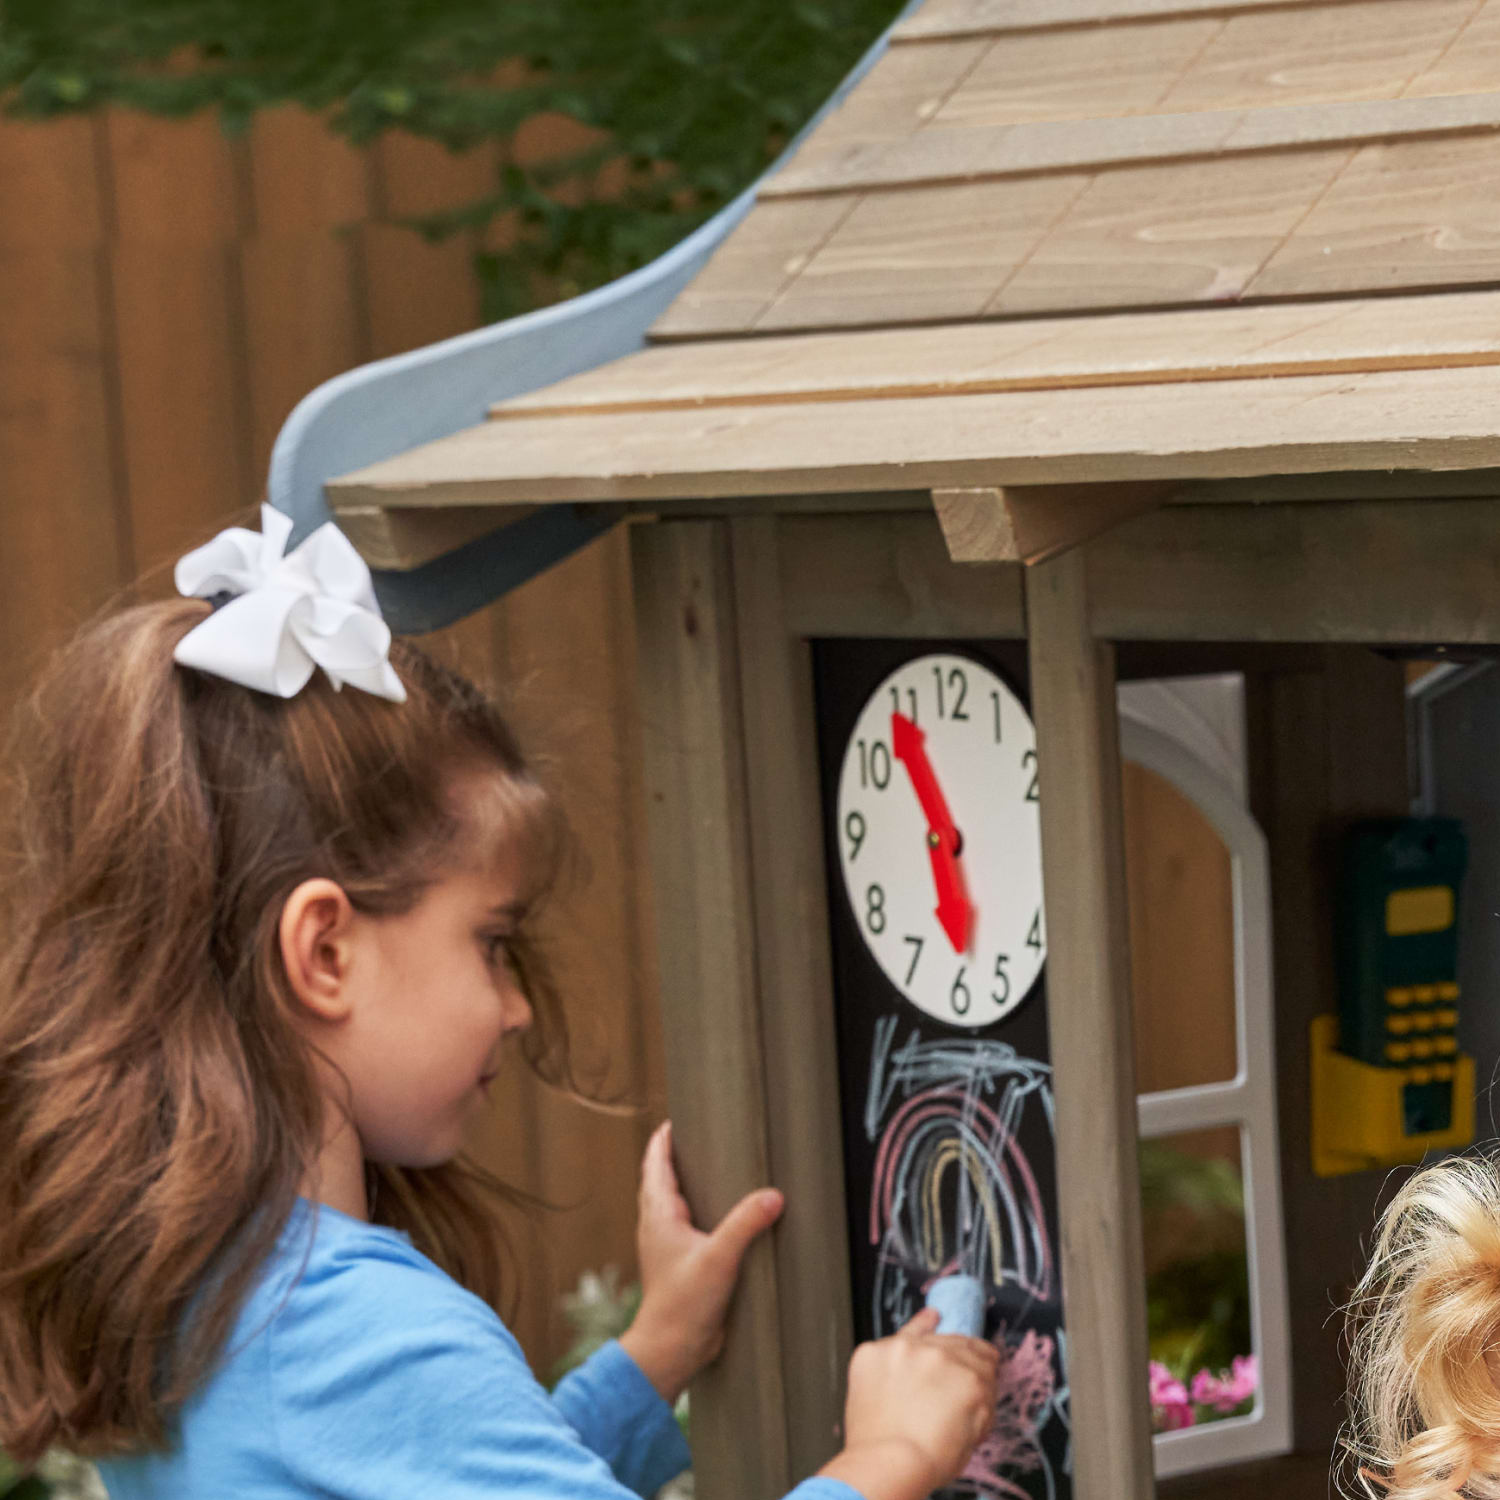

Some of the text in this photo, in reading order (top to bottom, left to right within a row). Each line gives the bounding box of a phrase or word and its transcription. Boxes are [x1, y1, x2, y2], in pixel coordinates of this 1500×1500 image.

[933, 666, 969, 721] 12
[990, 690, 1002, 744] 1
[856, 739, 892, 790] 10
[1021, 750, 1040, 802] 2
[845, 811, 866, 861] 9
[866, 884, 886, 935] 8
[1027, 909, 1042, 955] 4
[903, 937, 924, 986] 7
[991, 955, 1011, 1005] 5
[950, 967, 971, 1015] 6
